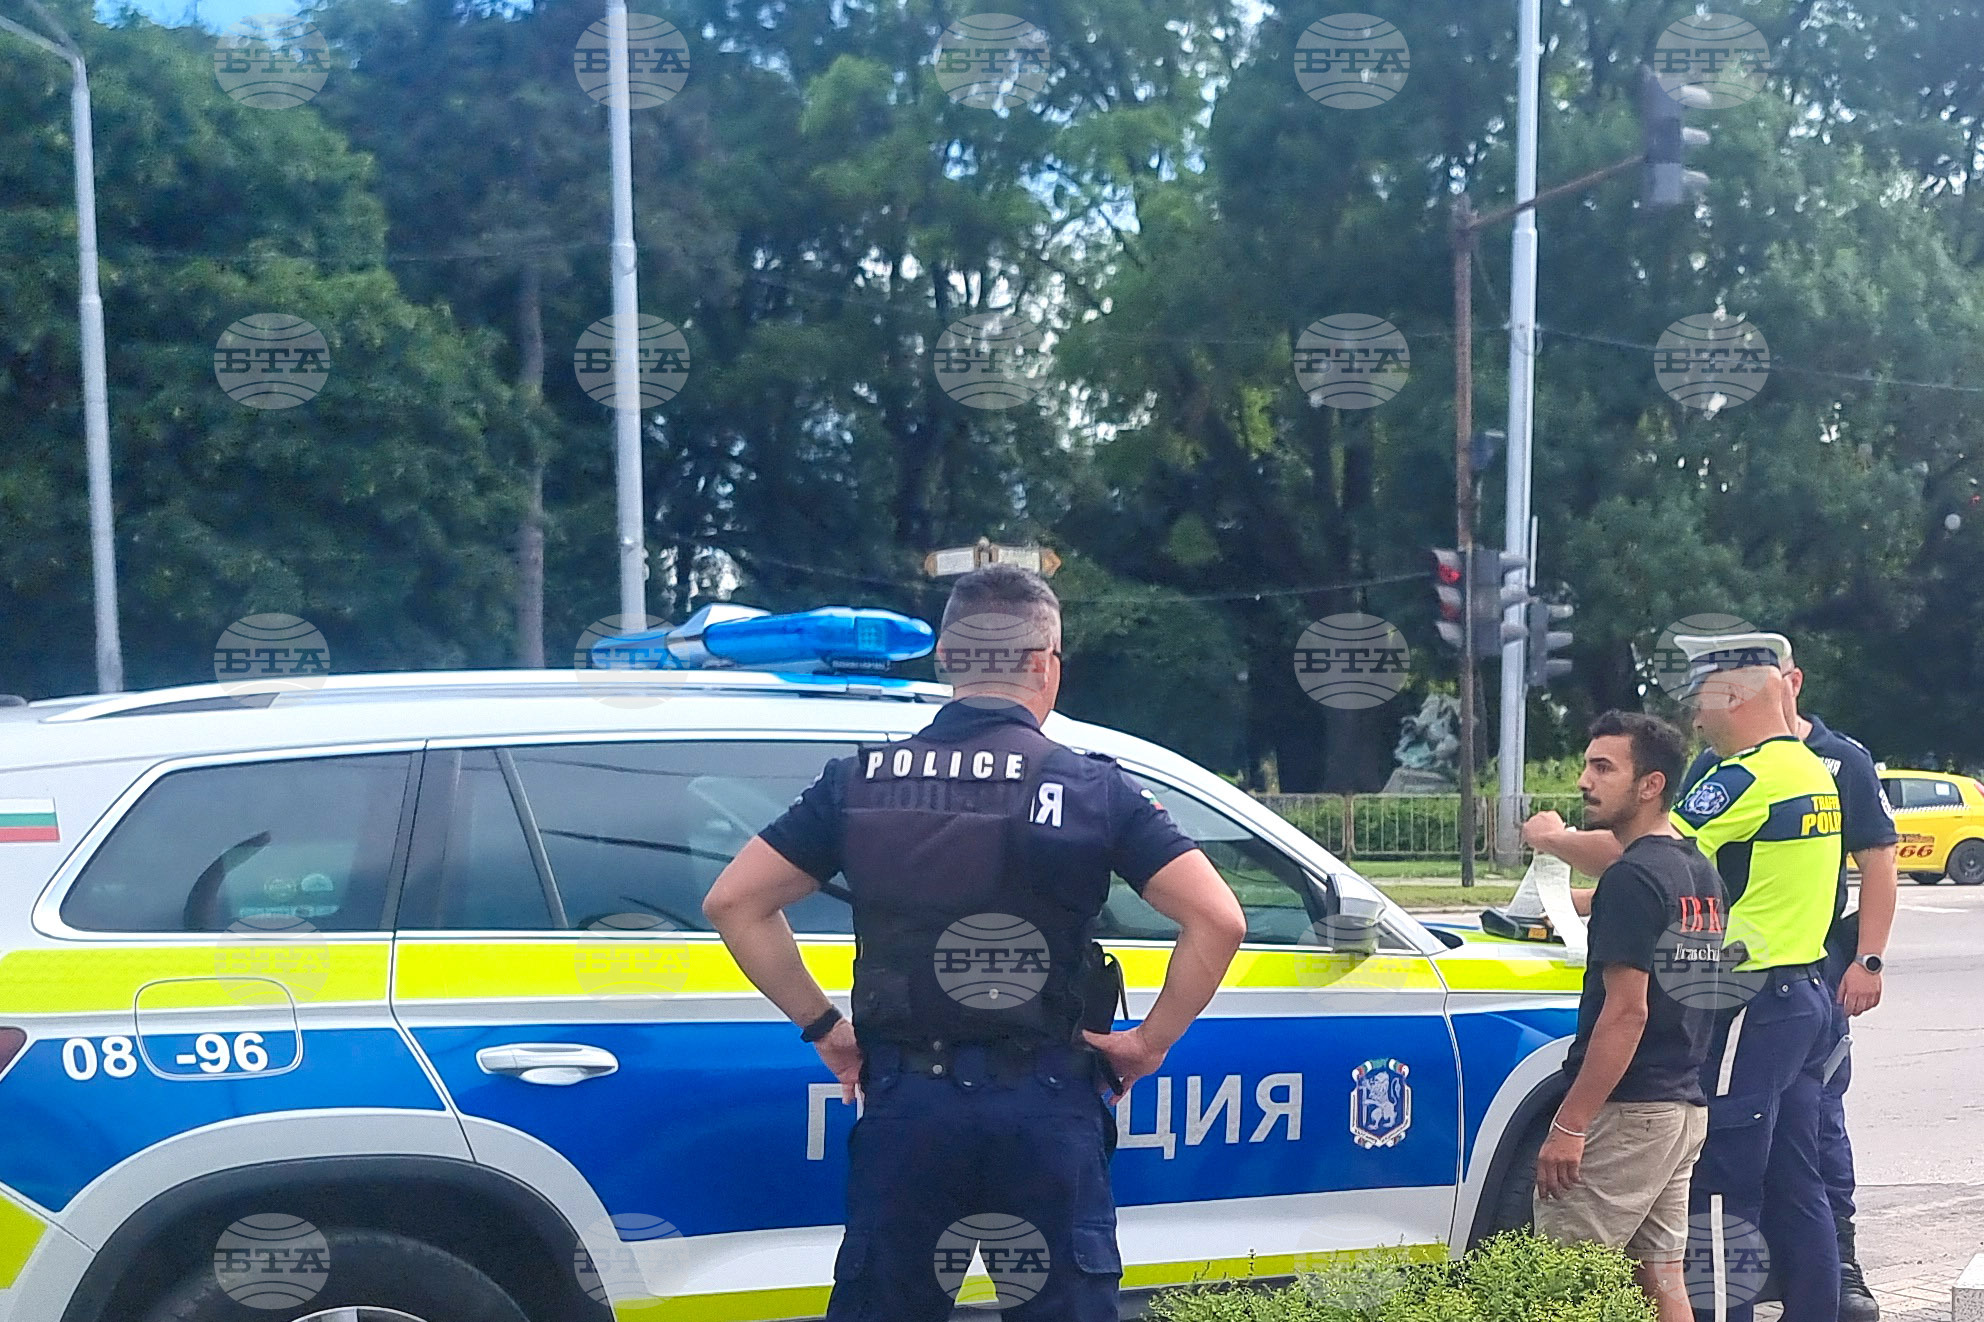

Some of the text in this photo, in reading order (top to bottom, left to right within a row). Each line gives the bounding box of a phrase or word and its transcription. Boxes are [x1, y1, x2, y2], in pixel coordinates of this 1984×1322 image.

[866, 749, 1023, 779] POLICE
[1894, 845, 1934, 858] 66
[807, 1073, 1303, 1160] ПЦИЯ
